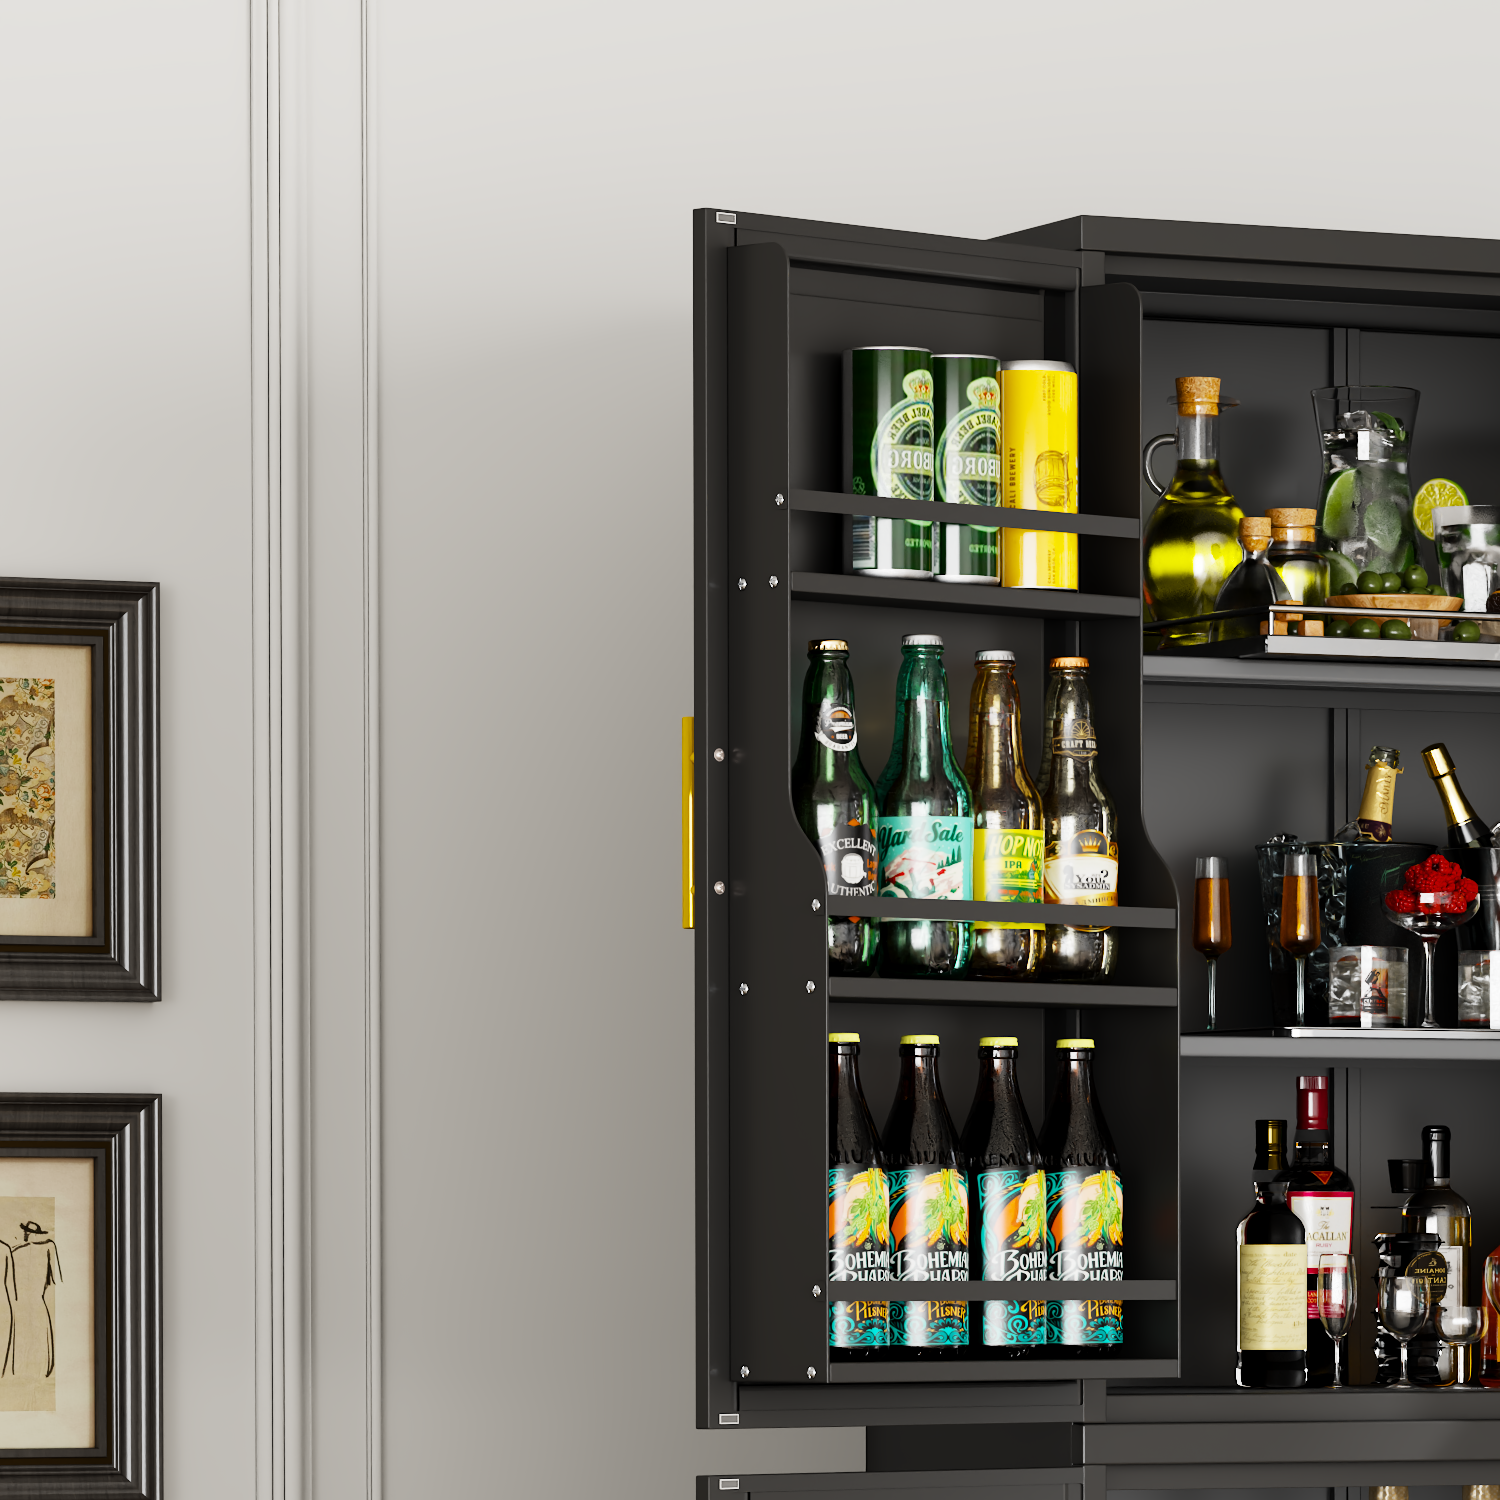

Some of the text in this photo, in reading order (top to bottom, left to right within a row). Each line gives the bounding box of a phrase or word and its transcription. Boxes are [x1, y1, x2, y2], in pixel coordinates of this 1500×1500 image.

[1009, 447, 1017, 486] BREWERY
[926, 821, 964, 843] Sale
[820, 838, 877, 857] EXCELLENT
[988, 834, 1022, 857] HOP
[1004, 860, 1022, 869] IPA
[1306, 1231, 1348, 1241] ACALLAN
